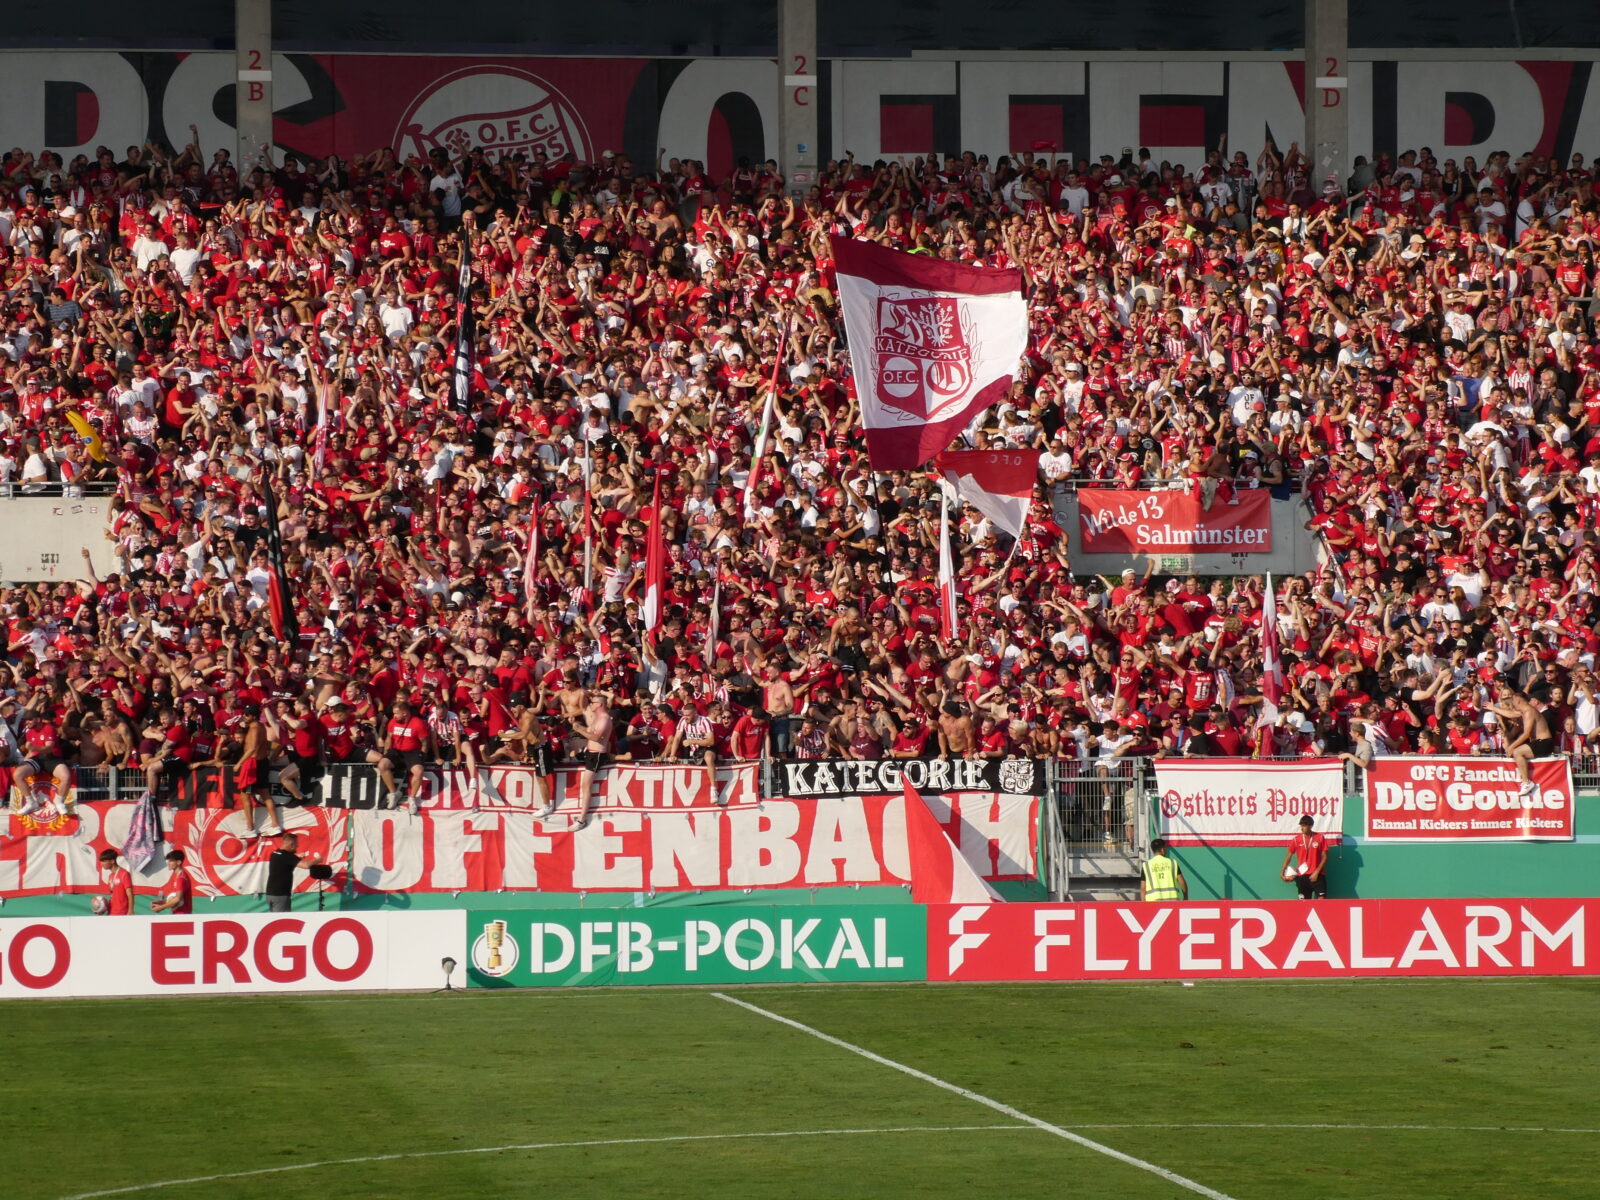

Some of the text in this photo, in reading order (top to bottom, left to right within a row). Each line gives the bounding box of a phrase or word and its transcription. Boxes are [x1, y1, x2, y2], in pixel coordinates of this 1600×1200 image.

[248, 50, 262, 70] 2
[794, 55, 807, 75] 2
[1325, 58, 1338, 77] 2
[247, 81, 264, 101] B
[793, 87, 808, 106] C
[1323, 89, 1340, 108] D
[478, 113, 554, 144] O.F.C.
[883, 371, 919, 383] O.F.C.
[1080, 495, 1164, 536] Wilde 13
[1136, 524, 1268, 545] Salmünster
[785, 759, 991, 796] KATEGORIE
[1410, 765, 1449, 781] OFC
[1161, 788, 1339, 822] Ostkreis Power
[1375, 782, 1436, 811] Die
[1372, 817, 1563, 830] Einmal Kickers immer Kickers
[531, 917, 904, 973] DFB-POKAL
[1034, 904, 1586, 972] FLYERALARM
[0, 924, 71, 989] O
[151, 917, 373, 985] ERGO
